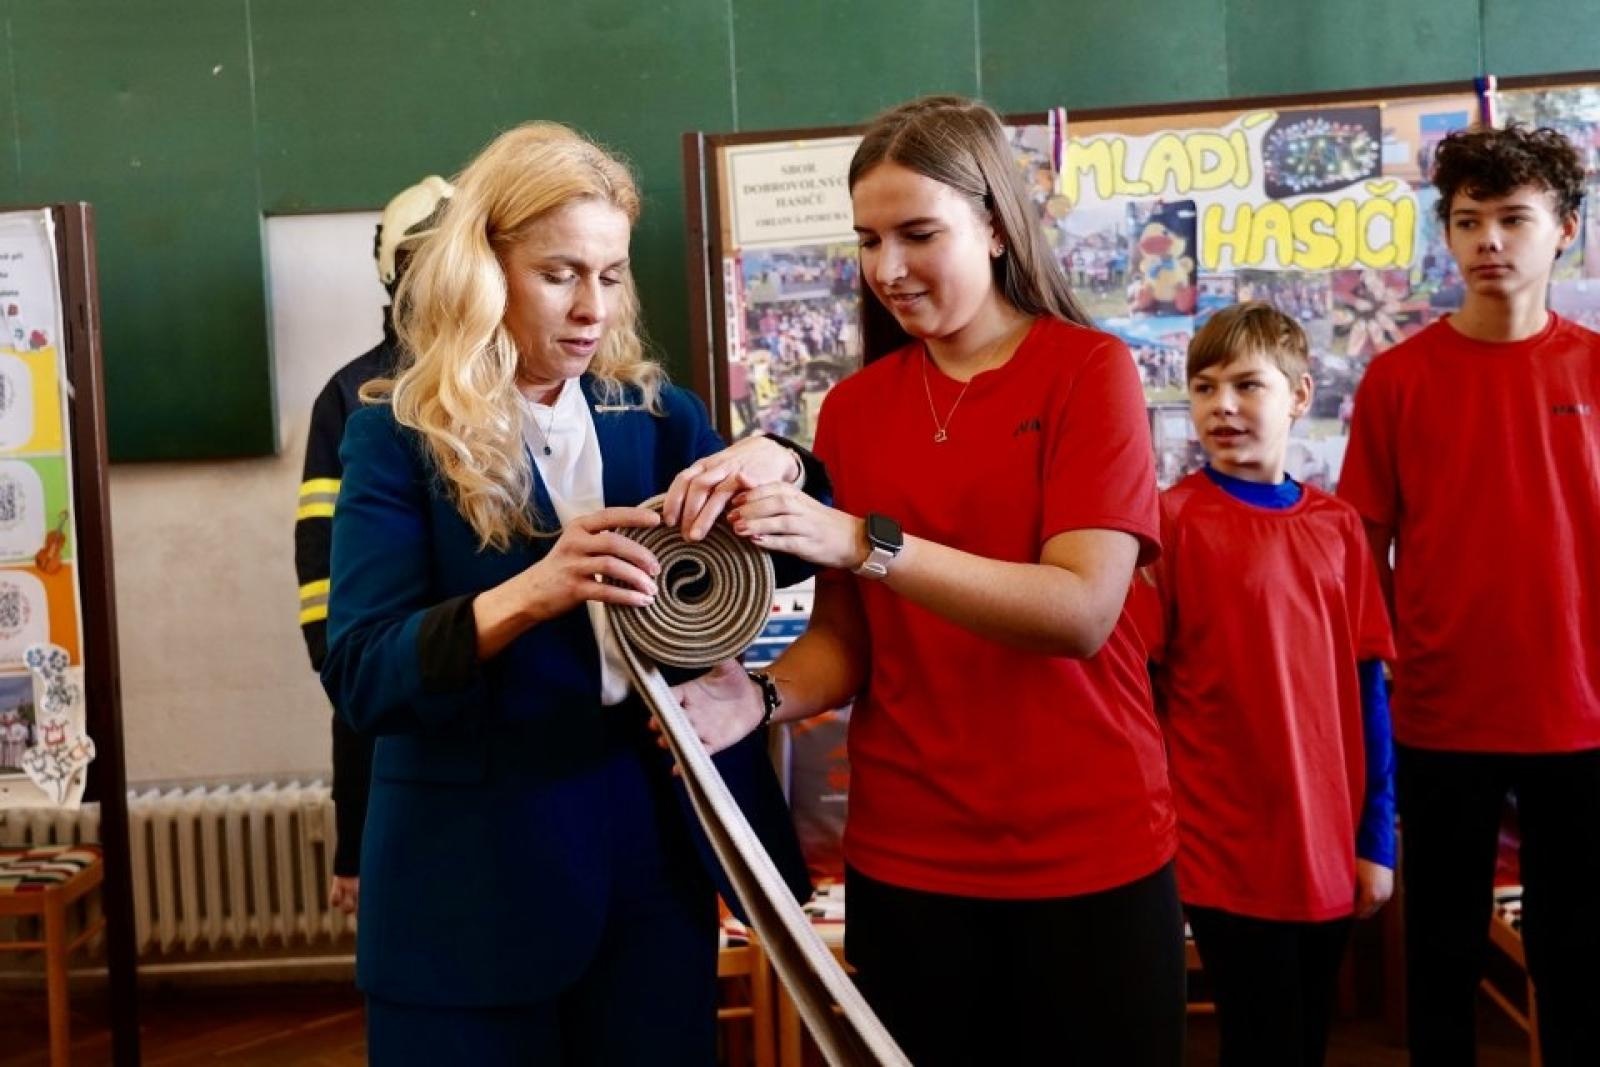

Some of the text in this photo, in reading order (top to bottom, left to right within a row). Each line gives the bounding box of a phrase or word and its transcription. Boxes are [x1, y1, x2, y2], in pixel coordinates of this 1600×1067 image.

[780, 163, 816, 175] SBOR
[1060, 110, 1278, 206] MLADÍ
[743, 176, 844, 195] DOBROVOLNÝC
[1203, 180, 1416, 270] HASIČI
